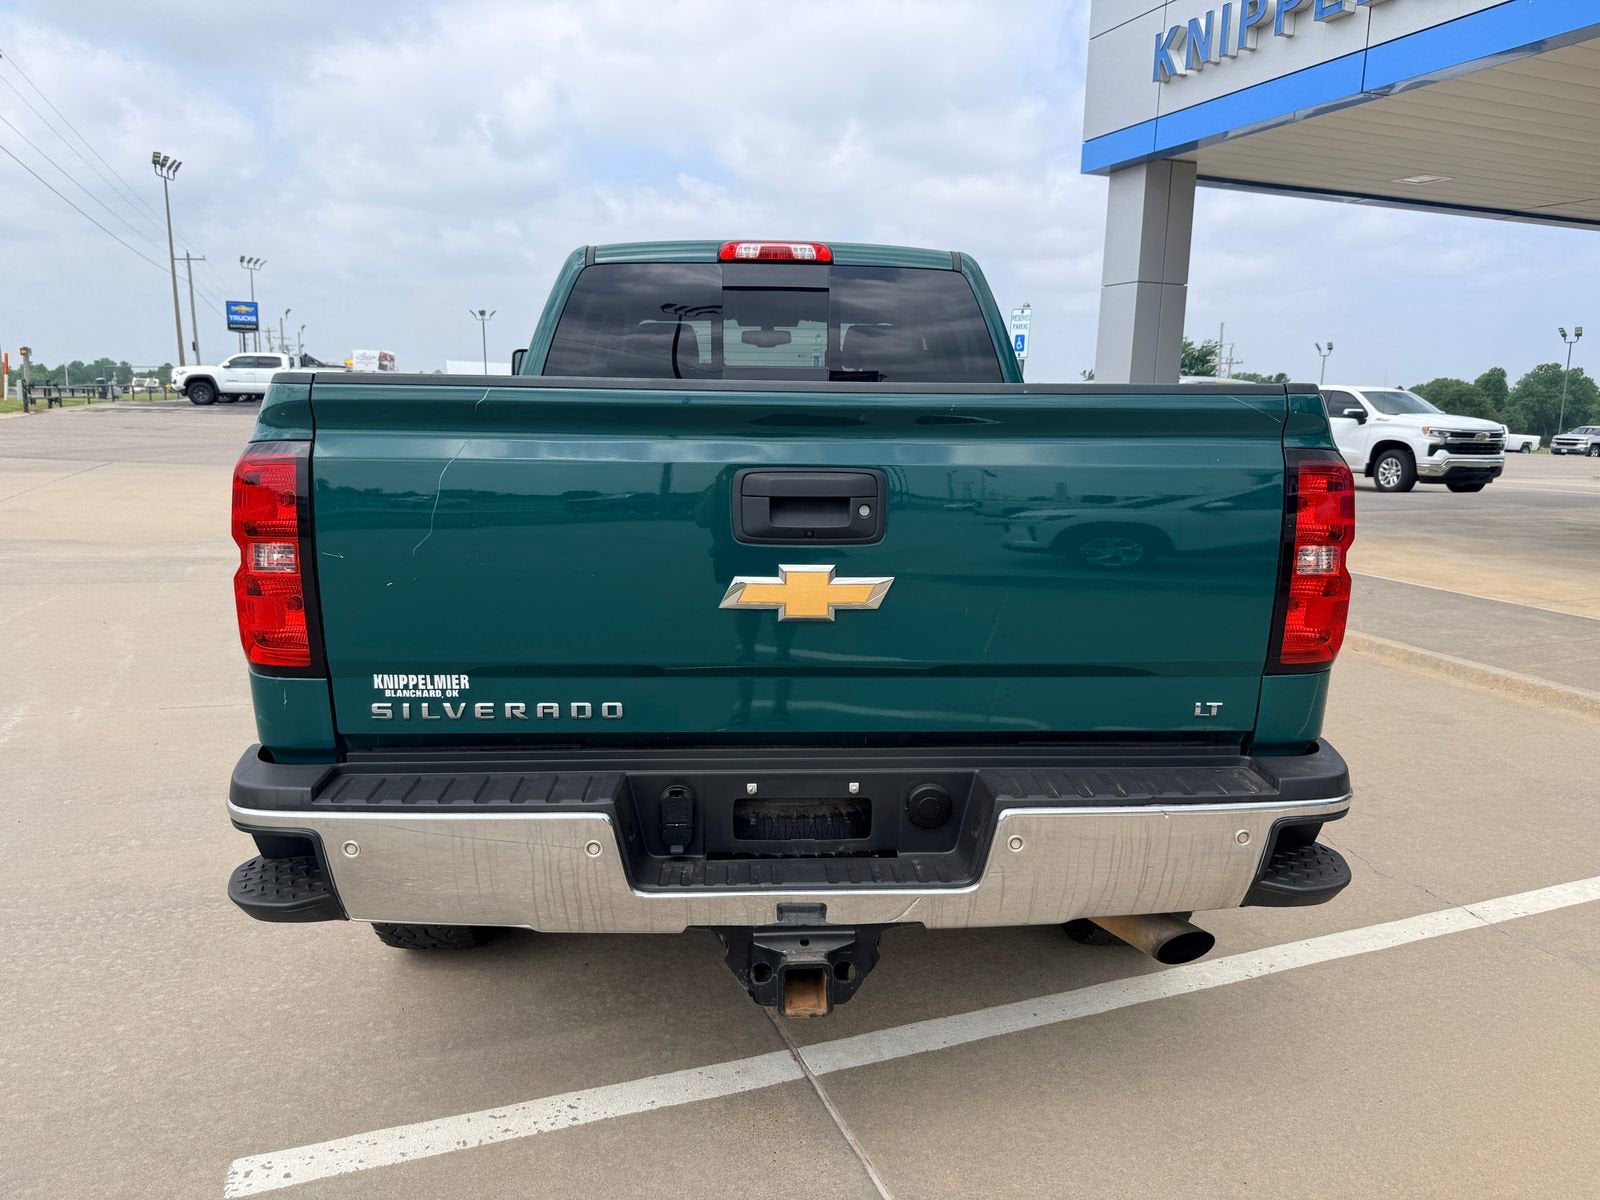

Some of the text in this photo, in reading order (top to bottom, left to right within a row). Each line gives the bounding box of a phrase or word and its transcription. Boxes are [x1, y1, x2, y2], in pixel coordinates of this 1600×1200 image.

[1153, 0, 1376, 83] KNIPP
[228, 314, 257, 322] TRUCKS
[373, 673, 470, 690] KNIPPELMIER
[384, 689, 459, 698] BLANCHARD, OK
[371, 701, 624, 721] SILVERADO
[1194, 702, 1223, 716] LT
